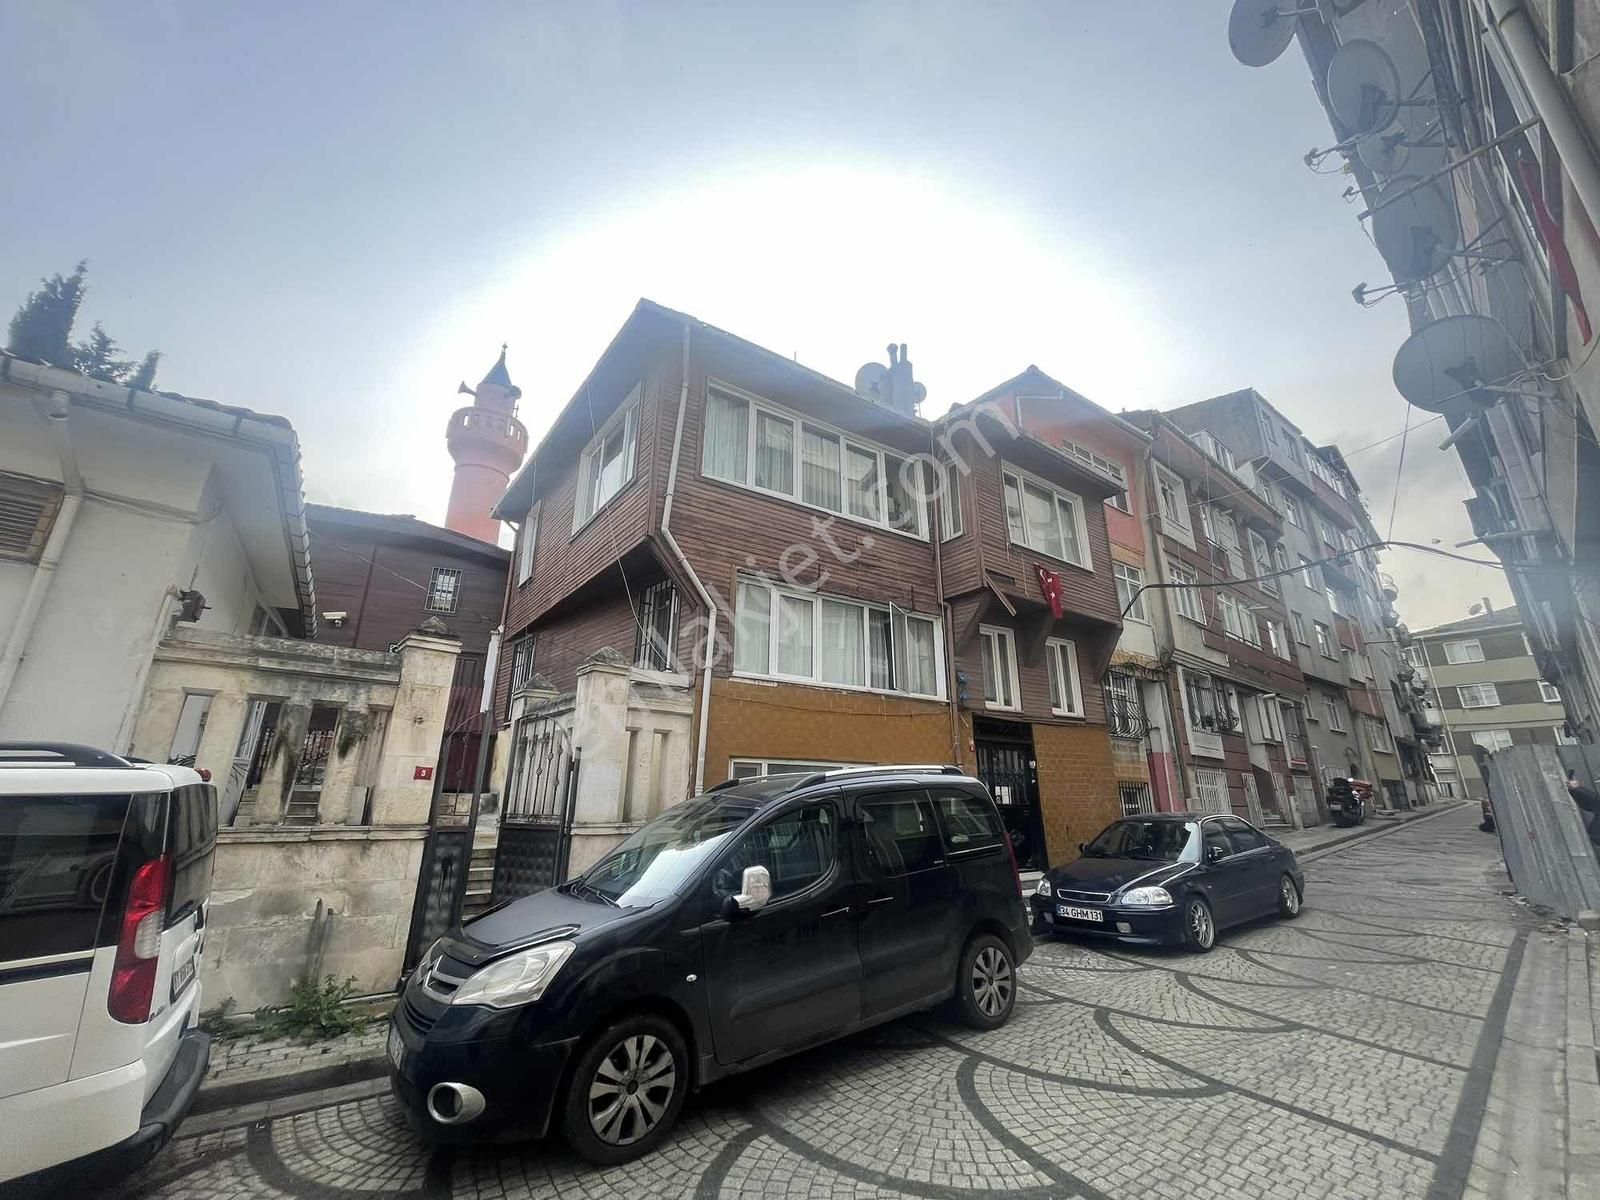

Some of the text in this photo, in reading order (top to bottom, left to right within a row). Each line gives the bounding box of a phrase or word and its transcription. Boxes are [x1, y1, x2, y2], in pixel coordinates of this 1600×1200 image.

[420, 769, 426, 777] 3
[1060, 906, 1103, 920] 34 GHM 131
